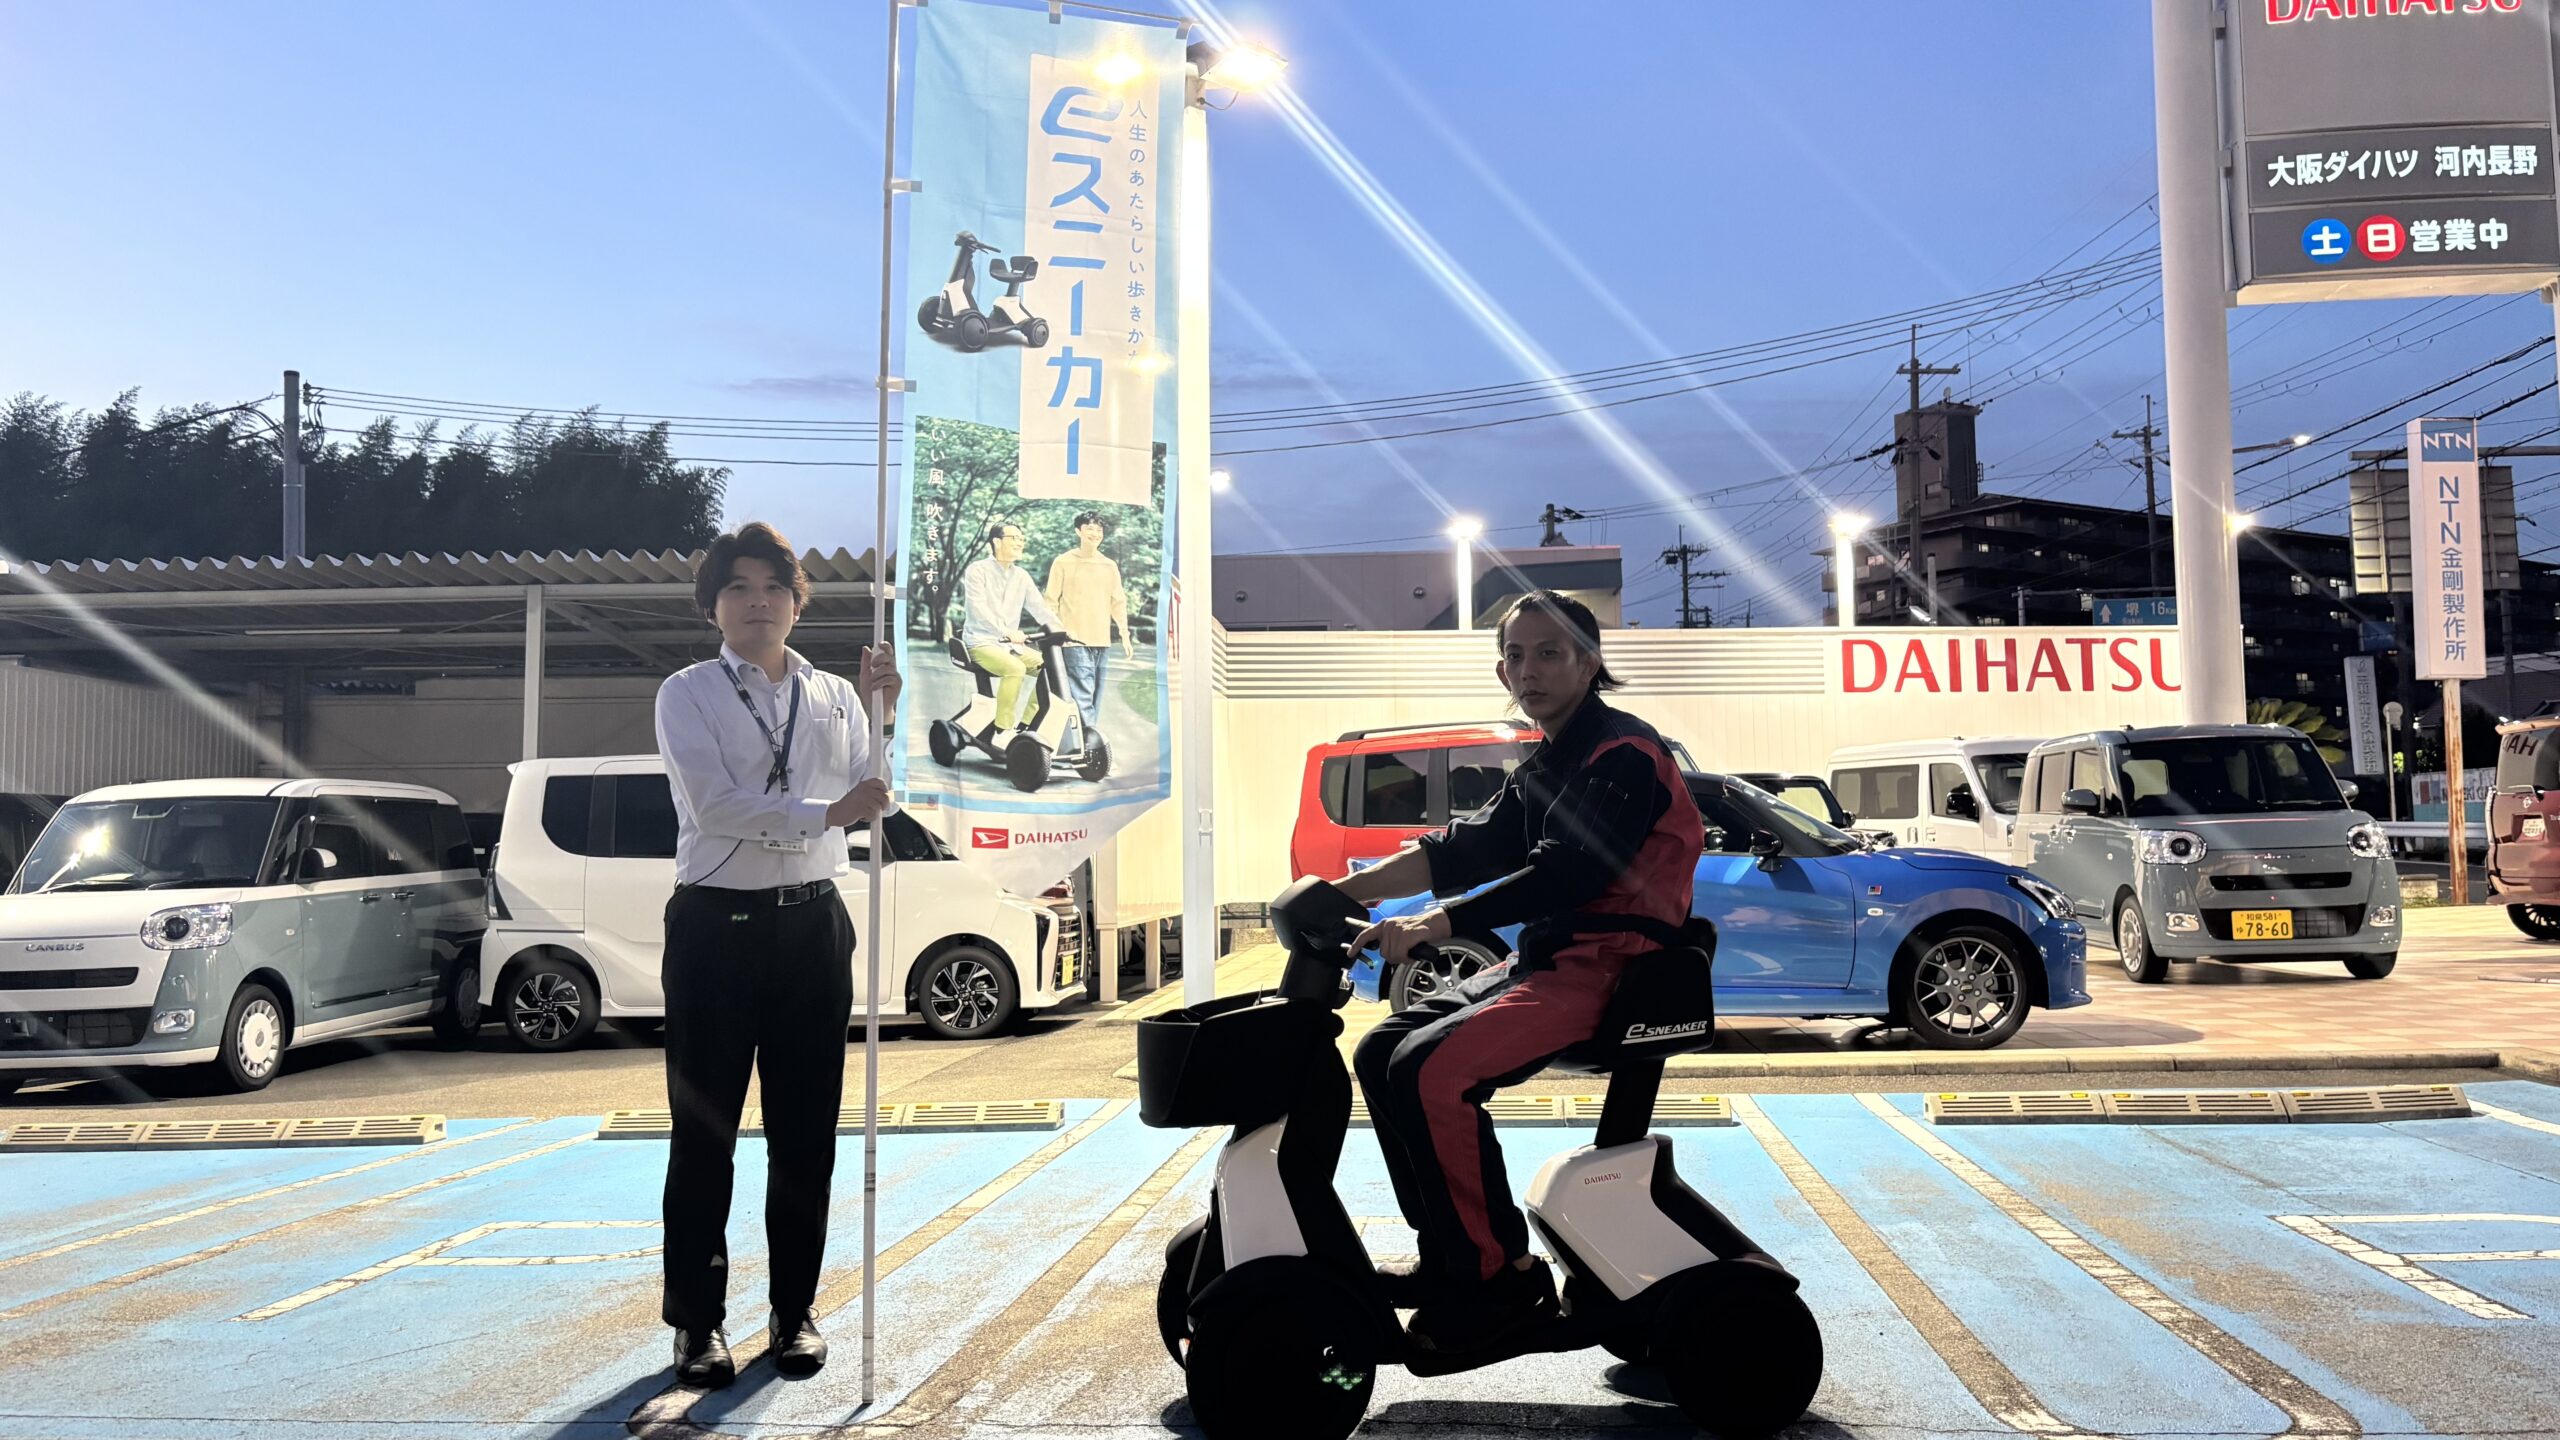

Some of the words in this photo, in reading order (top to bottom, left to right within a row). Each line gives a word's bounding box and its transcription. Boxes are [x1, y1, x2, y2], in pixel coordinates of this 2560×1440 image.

[2267, 149, 2419, 187] 大阪ダイハツ
[2434, 145, 2537, 177] 河内長野
[2310, 225, 2344, 256] 土
[2366, 223, 2397, 253] 日
[2409, 217, 2508, 252] 営業中
[2423, 432, 2472, 449] NTN
[923, 428, 946, 592] いい風、吹きます。
[2439, 476, 2467, 662] NTN金剛製作所
[1841, 638, 2182, 692] DAIHATSU
[1015, 828, 1088, 845] DAIHATSU
[2245, 921, 2289, 937] 78-60
[25, 942, 84, 952] CANBUS
[1584, 1172, 1622, 1185] DAIHATSU
